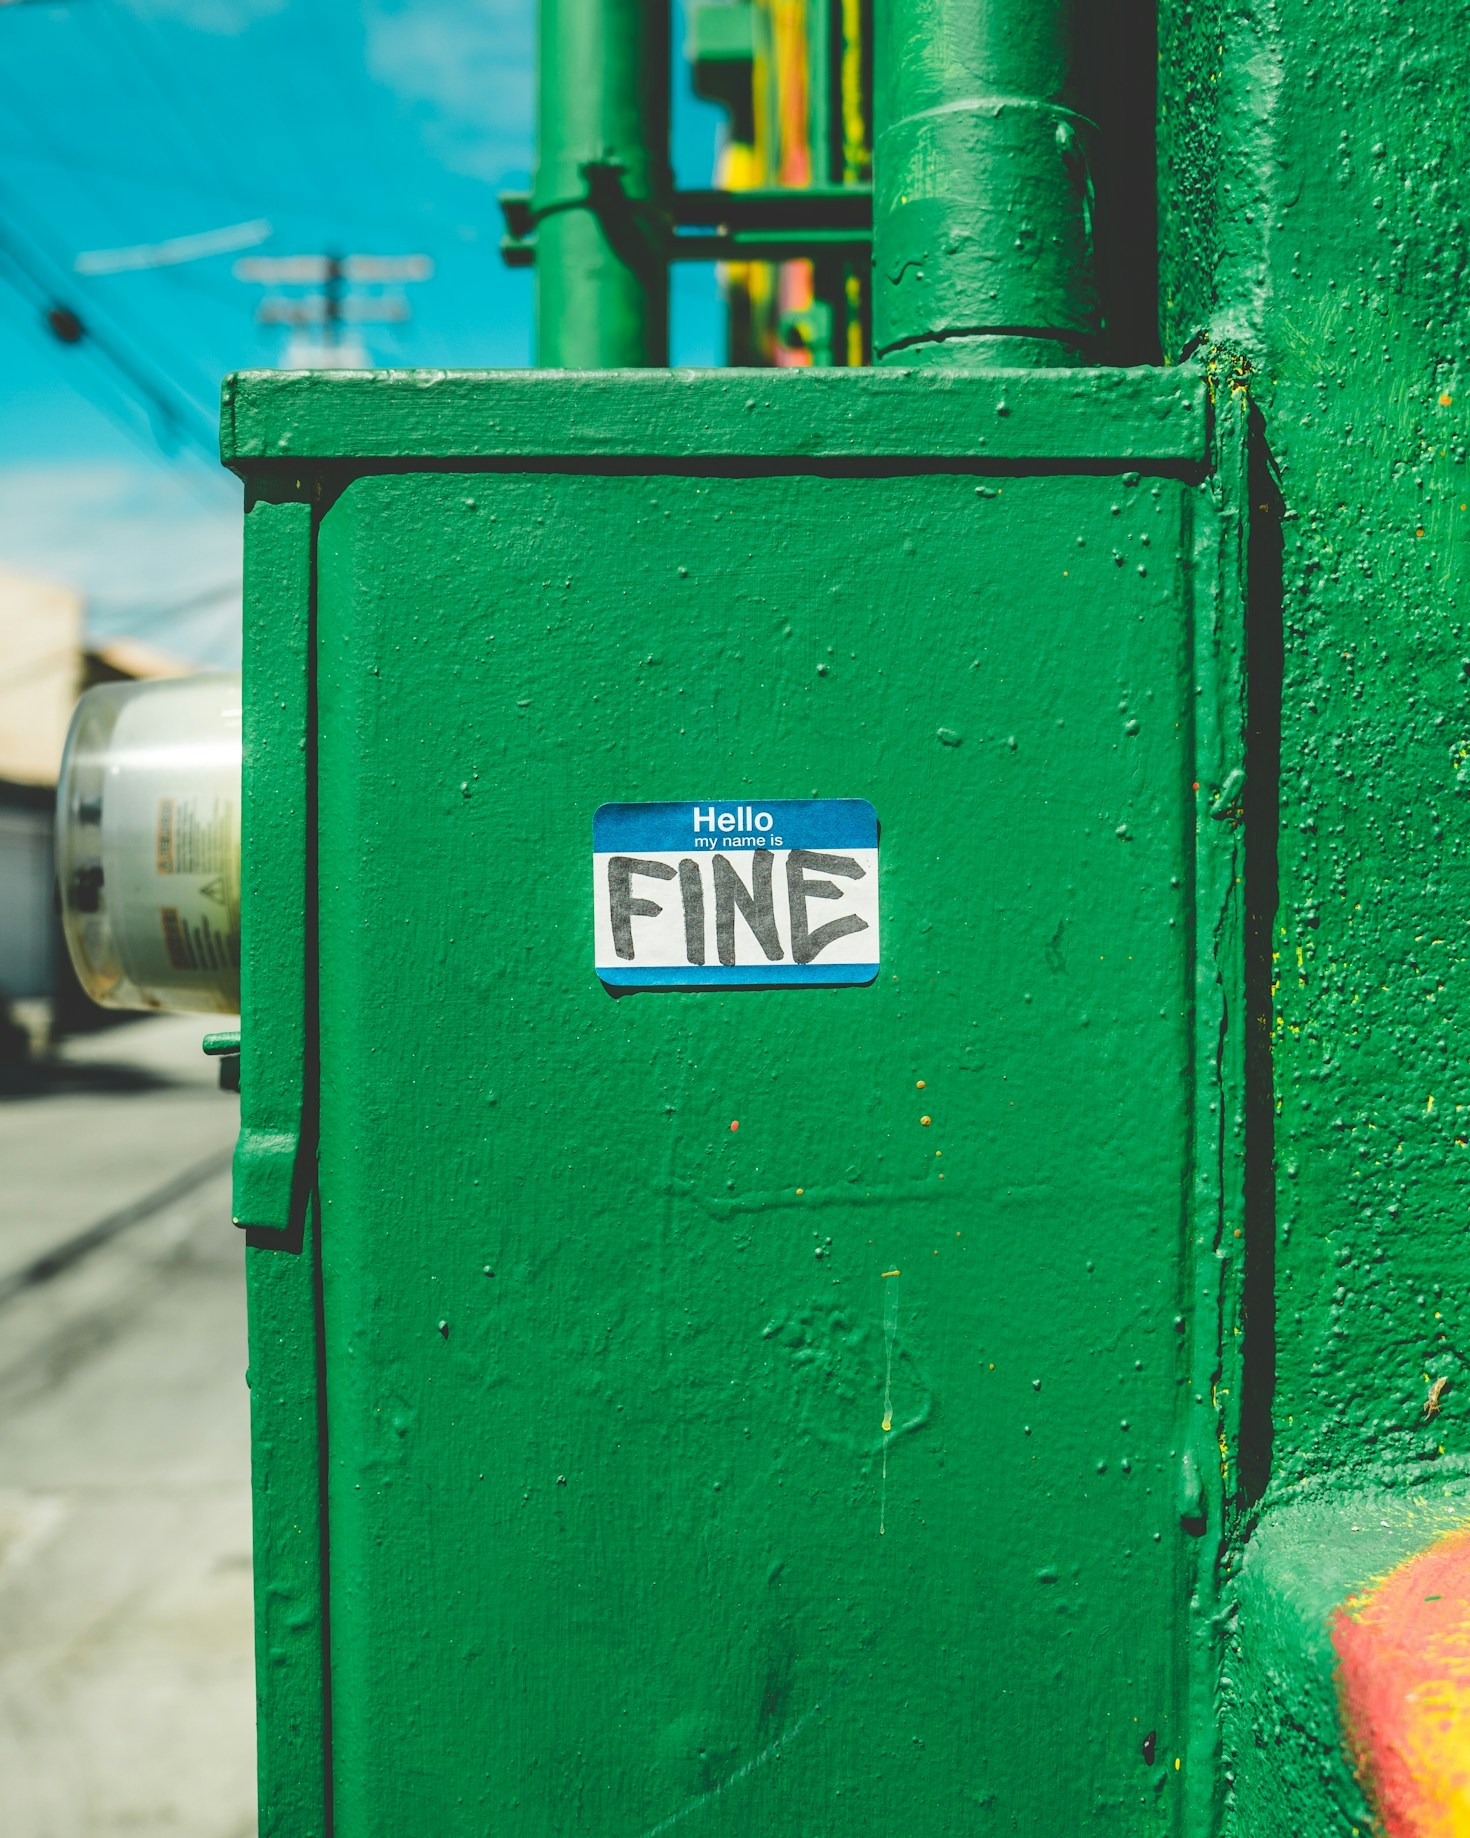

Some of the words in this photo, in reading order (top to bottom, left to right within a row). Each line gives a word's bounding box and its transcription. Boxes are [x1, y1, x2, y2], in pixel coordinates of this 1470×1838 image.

[693, 806, 774, 832] Hello
[694, 836, 718, 850] my
[722, 836, 766, 847] name
[770, 833, 784, 846] is
[608, 848, 869, 967] FINE
